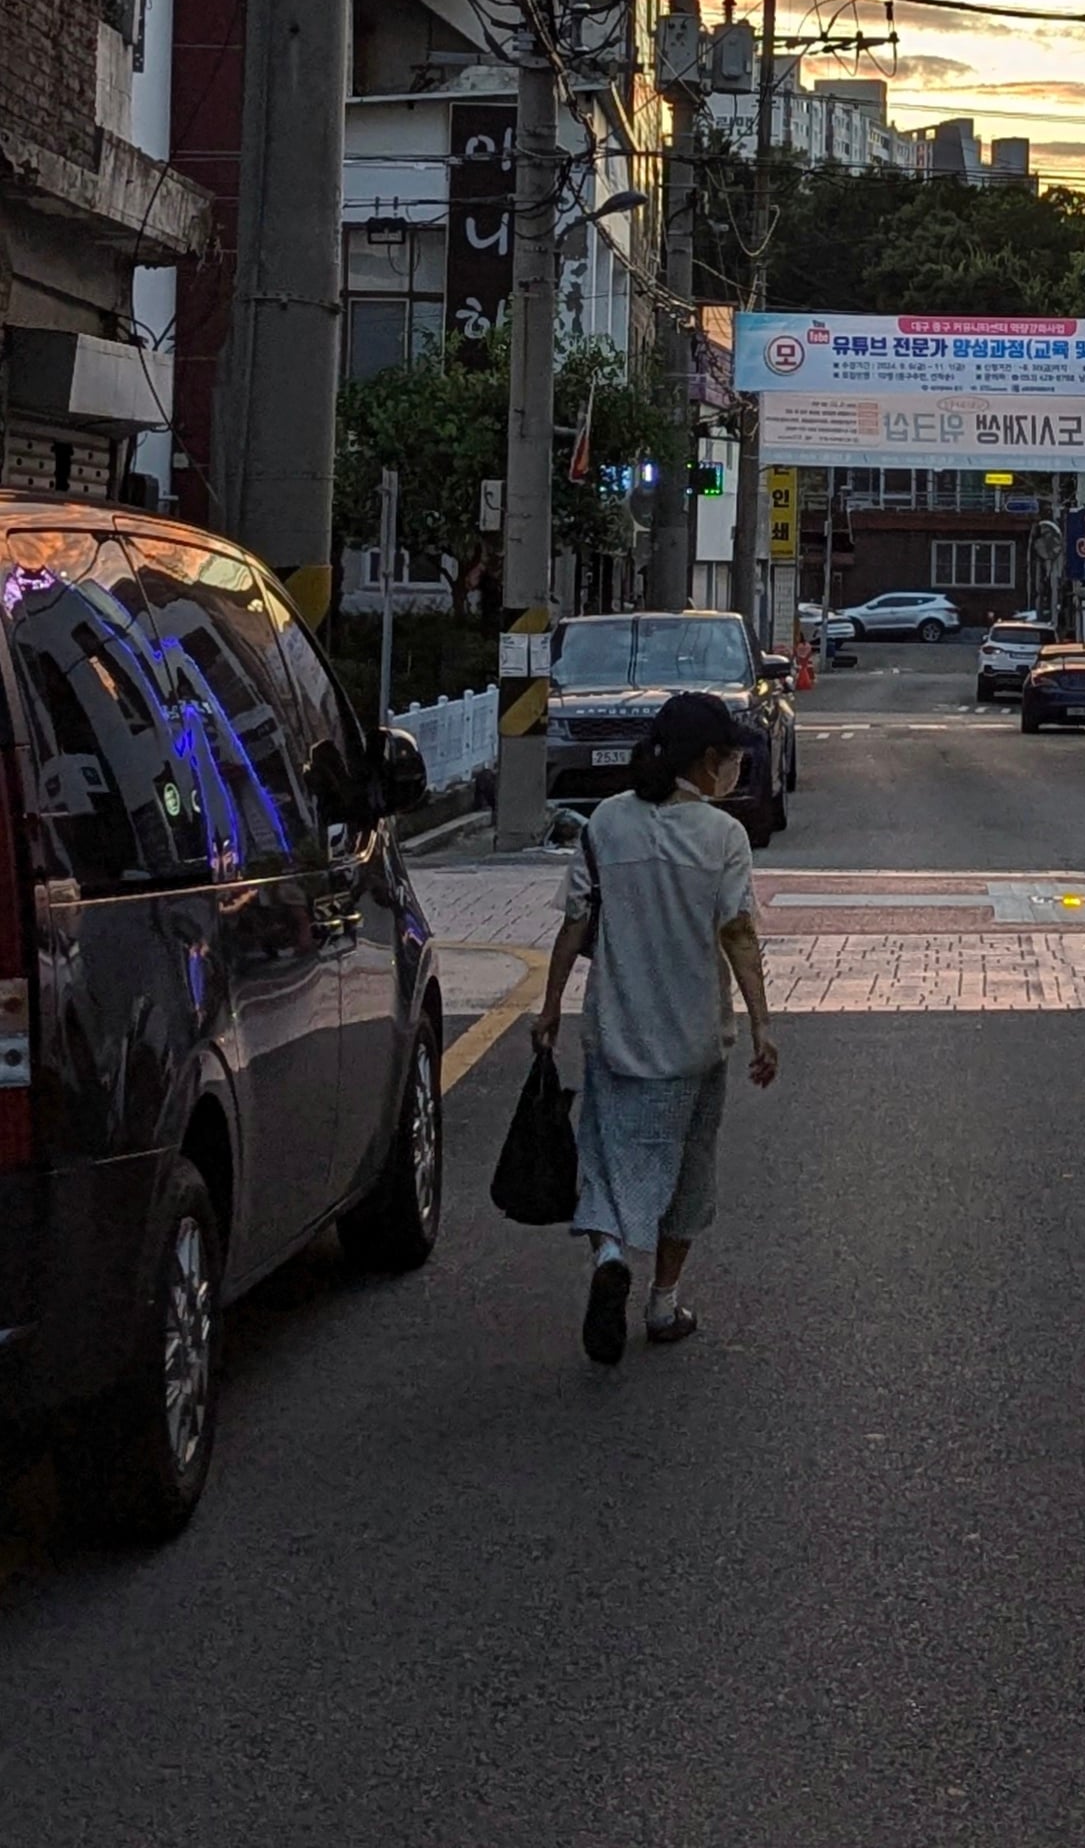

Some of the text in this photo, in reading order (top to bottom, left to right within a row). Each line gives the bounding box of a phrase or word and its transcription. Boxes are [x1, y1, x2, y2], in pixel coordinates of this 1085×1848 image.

[775, 343, 797, 366] 모
[832, 336, 888, 357] 유튜브
[893, 336, 948, 358] 전문가
